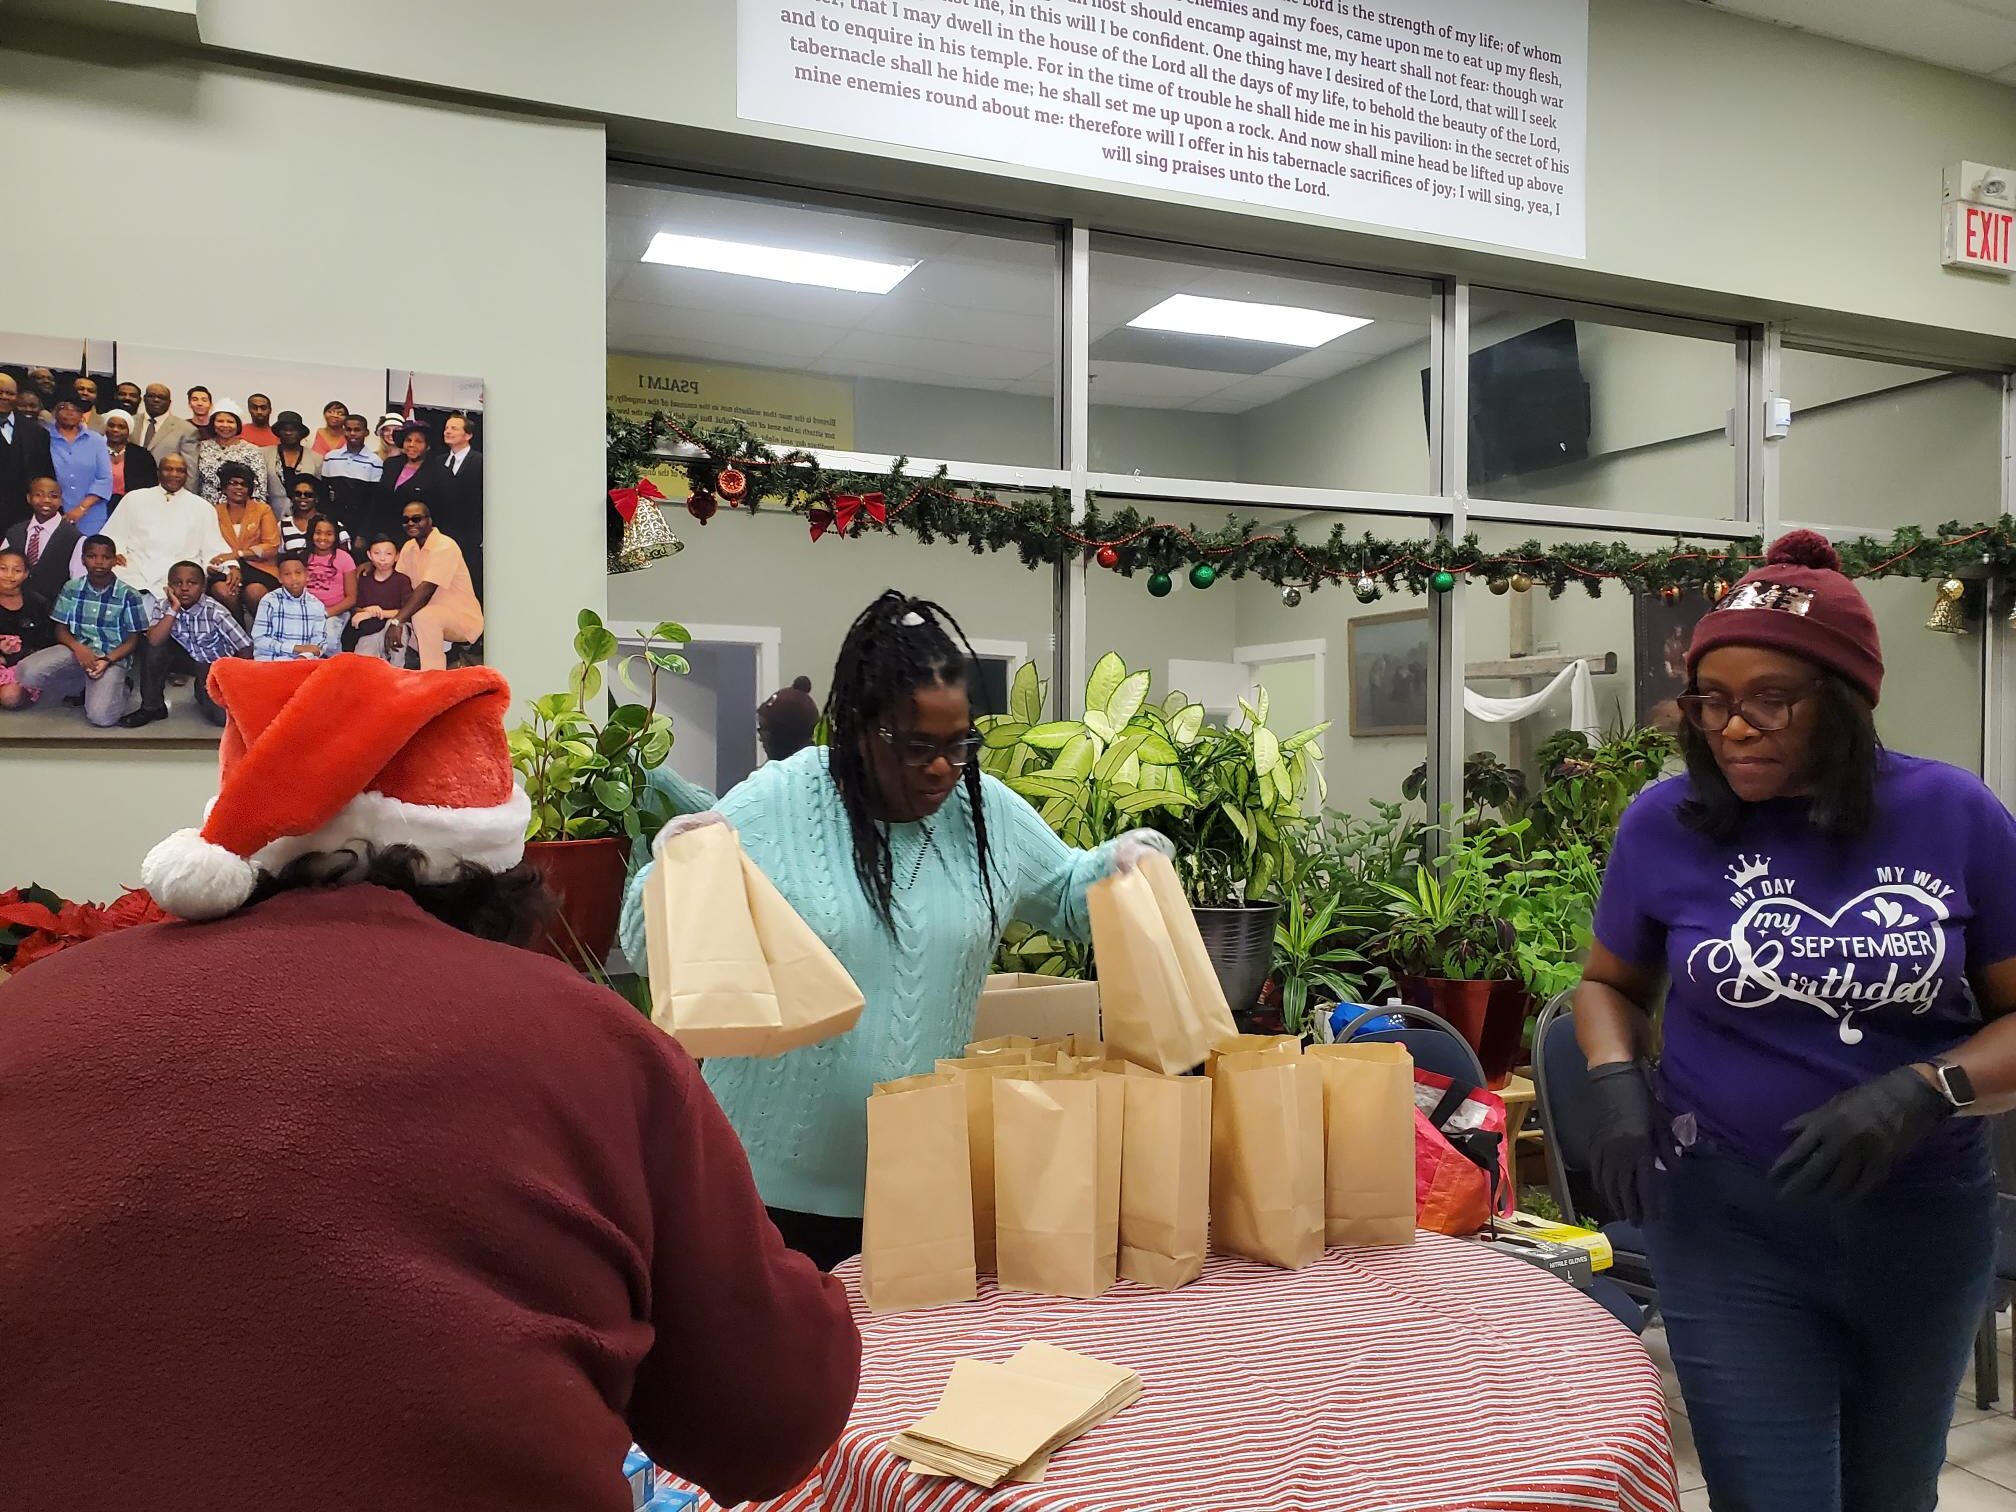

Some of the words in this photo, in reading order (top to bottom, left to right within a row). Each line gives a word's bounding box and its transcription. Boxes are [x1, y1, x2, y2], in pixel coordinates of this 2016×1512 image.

[1131, 2, 1182, 26] should
[1187, 17, 1245, 42] encamp
[1249, 31, 1302, 52] against
[1306, 43, 1331, 60] me,
[1335, 49, 1358, 67] my
[1361, 51, 1397, 72] heart
[1400, 61, 1431, 80] shall
[1435, 71, 1457, 85] not
[1460, 73, 1489, 92] fear:
[1493, 81, 1537, 104] though
[1540, 95, 1564, 109] war
[1252, 8, 1279, 23] and
[1283, 14, 1306, 32] my
[1310, 17, 1342, 40] foes,
[1346, 29, 1382, 46] came
[1386, 37, 1420, 55] upon
[1424, 46, 1443, 60] me
[1447, 49, 1460, 63] to
[1463, 56, 1483, 69] eat
[1486, 60, 1502, 76] up
[1506, 65, 1526, 81] my
[1529, 67, 1562, 88] flesh,
[1378, 12, 1435, 35] strength
[1439, 25, 1453, 39] of
[1455, 31, 1476, 48] my
[1479, 32, 1503, 52] life;
[1507, 41, 1521, 55] of
[1523, 45, 1562, 64] whom
[781, 10, 816, 28] and
[821, 15, 839, 32] to
[845, 23, 913, 46] enquire
[918, 32, 935, 51] in
[940, 36, 965, 56] his
[970, 45, 1032, 70] temple.
[1037, 56, 1063, 75] For
[1068, 62, 1084, 80] in
[1088, 67, 1114, 85] the
[1118, 73, 1153, 93] time
[1158, 82, 1175, 97] of
[1178, 86, 1231, 108] trouble
[1235, 95, 1253, 112] he
[1257, 101, 1291, 120] shall
[1295, 107, 1325, 126] hide
[1329, 118, 1350, 131] me
[1354, 119, 1367, 135] in
[1371, 122, 1391, 139] his
[1394, 130, 1451, 151] pavilion:
[1455, 139, 1468, 155] in
[1471, 143, 1492, 159] the
[1495, 151, 1532, 167] secret
[1535, 157, 1549, 170] of
[1551, 158, 1569, 174] his
[903, 7, 942, 29] may
[946, 13, 992, 36] dwell
[997, 22, 1014, 40] in
[1019, 28, 1045, 46] the
[1049, 33, 1097, 57] house
[1102, 46, 1119, 61] of
[1122, 49, 1147, 67] the
[1152, 54, 1186, 75] Lord
[1190, 64, 1208, 79] all
[1212, 68, 1236, 85] the
[1240, 73, 1273, 94] days
[1277, 82, 1293, 96] of
[1296, 88, 1319, 105] my
[1323, 89, 1348, 110] life,
[1352, 97, 1366, 111] to
[1369, 99, 1415, 121] behold
[1418, 110, 1439, 126] the
[1443, 114, 1487, 139] beauty
[1490, 126, 1504, 139] of
[1506, 128, 1526, 144] the
[1530, 133, 1560, 154] Lord,
[1066, 15, 1096, 32] will
[1100, 19, 1106, 34] I
[1110, 20, 1128, 39] be
[1132, 30, 1209, 56] confident.
[1213, 44, 1242, 62] One
[1246, 51, 1284, 75] thing
[1288, 58, 1322, 79] have
[1325, 67, 1332, 81] I
[1335, 69, 1384, 92] desired
[1388, 82, 1403, 96] of
[1405, 85, 1426, 101] the
[1430, 89, 1462, 111] Lord,
[1466, 98, 1492, 115] that
[1495, 105, 1518, 121] will
[1521, 109, 1527, 122] I
[1529, 114, 1557, 129] seek
[790, 36, 885, 67] tabernacle
[891, 55, 932, 76] shall
[937, 62, 958, 81] he
[962, 67, 999, 88] hide
[1004, 79, 1034, 96] me;
[1038, 81, 1058, 99] he
[1063, 87, 1101, 108] shall
[1105, 98, 1128, 112] set
[1133, 103, 1156, 118] me
[1160, 108, 1180, 126] up
[1184, 113, 1222, 130] upon
[1226, 121, 1235, 133] a
[1239, 123, 1274, 140] rock.
[1278, 128, 1307, 146] And
[1311, 137, 1341, 152] now
[1345, 141, 1377, 159] shall
[1381, 149, 1414, 166] mine
[1418, 154, 1449, 173] head
[1453, 160, 1467, 176] be
[1471, 164, 1504, 184] lifted
[1508, 175, 1524, 190] up
[1527, 176, 1563, 195] above
[795, 65, 841, 86] mine
[847, 77, 921, 100] enemies
[926, 90, 977, 110] round
[982, 98, 1030, 120] about
[1035, 110, 1063, 125] me:
[1069, 113, 1142, 140] therefore
[1146, 129, 1175, 146] will
[1178, 133, 1185, 147] I
[1188, 136, 1225, 155] offer
[1229, 141, 1243, 158] in
[1247, 145, 1269, 162] his
[1273, 152, 1346, 176] tabernacle
[1350, 168, 1412, 189] sacrifices
[1416, 178, 1431, 192] of
[1432, 179, 1456, 199] joy;
[1459, 185, 1465, 198] I
[1467, 188, 1492, 203] will
[1495, 192, 1524, 212] sing,
[1527, 201, 1552, 216] yea,
[1555, 203, 1561, 216] I
[1102, 146, 1131, 163] will
[1136, 150, 1167, 173] sing
[1172, 160, 1225, 179] praises
[1229, 169, 1264, 185] unto
[1268, 173, 1291, 190] the
[1295, 177, 1330, 197] Lord.
[1967, 208, 2012, 263] EXIT
[1729, 886, 1757, 910] MY
[1760, 878, 1796, 898] DAY
[1876, 866, 1905, 884] MY
[1912, 868, 1956, 899] WAY
[1753, 911, 1802, 937] my
[1790, 930, 1937, 958] SEPTEMBER
[1692, 939, 1943, 1014] Birthday
[1549, 1259, 1568, 1268] NITRILE
[1568, 1256, 1588, 1265] GLOVES
[1567, 1270, 1573, 1279] L
